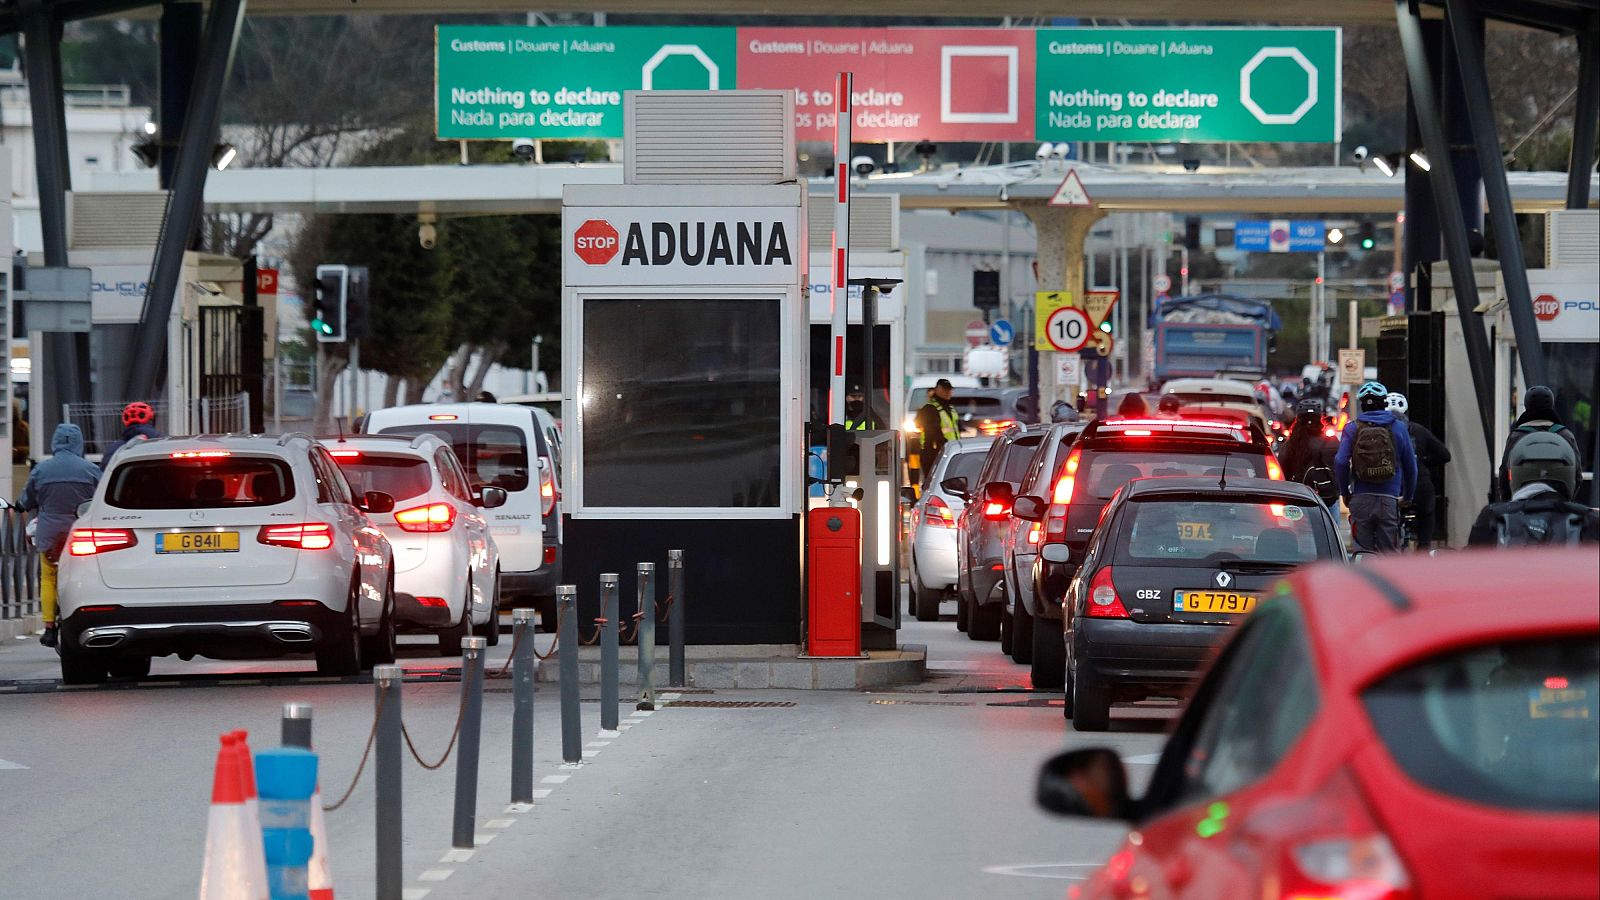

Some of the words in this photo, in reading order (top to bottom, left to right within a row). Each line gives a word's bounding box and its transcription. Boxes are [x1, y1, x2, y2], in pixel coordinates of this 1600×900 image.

[450, 39, 506, 52] Customs
[516, 39, 560, 52] Douane
[570, 39, 615, 53] Aduana
[749, 39, 804, 54] Customs
[814, 40, 859, 54] Douane
[869, 40, 914, 54] Aduana
[1049, 41, 1104, 54] Customs
[1113, 41, 1159, 55] Douane
[1168, 41, 1213, 55] Aduana
[451, 87, 525, 109] Nothing
[530, 88, 550, 105] to
[554, 86, 621, 105] declare
[812, 89, 833, 106] to
[851, 87, 903, 106] eclare
[1049, 89, 1122, 111] Nothing
[1127, 91, 1148, 107] to
[1152, 89, 1219, 107] declare
[451, 108, 494, 125] Nada
[499, 111, 535, 129] para
[539, 108, 604, 126] declarar
[856, 110, 920, 128] declarar
[1049, 111, 1092, 128] Nada
[1097, 113, 1132, 131] para
[1137, 110, 1202, 129] declarar
[577, 236, 616, 249] STOP
[621, 222, 792, 265] ADUANA
[1534, 302, 1558, 314] STOP
[1055, 319, 1081, 339] 10
[182, 534, 191, 548] G
[194, 534, 221, 548] 8411
[1136, 589, 1161, 600] GBZ
[1189, 593, 1199, 609] G
